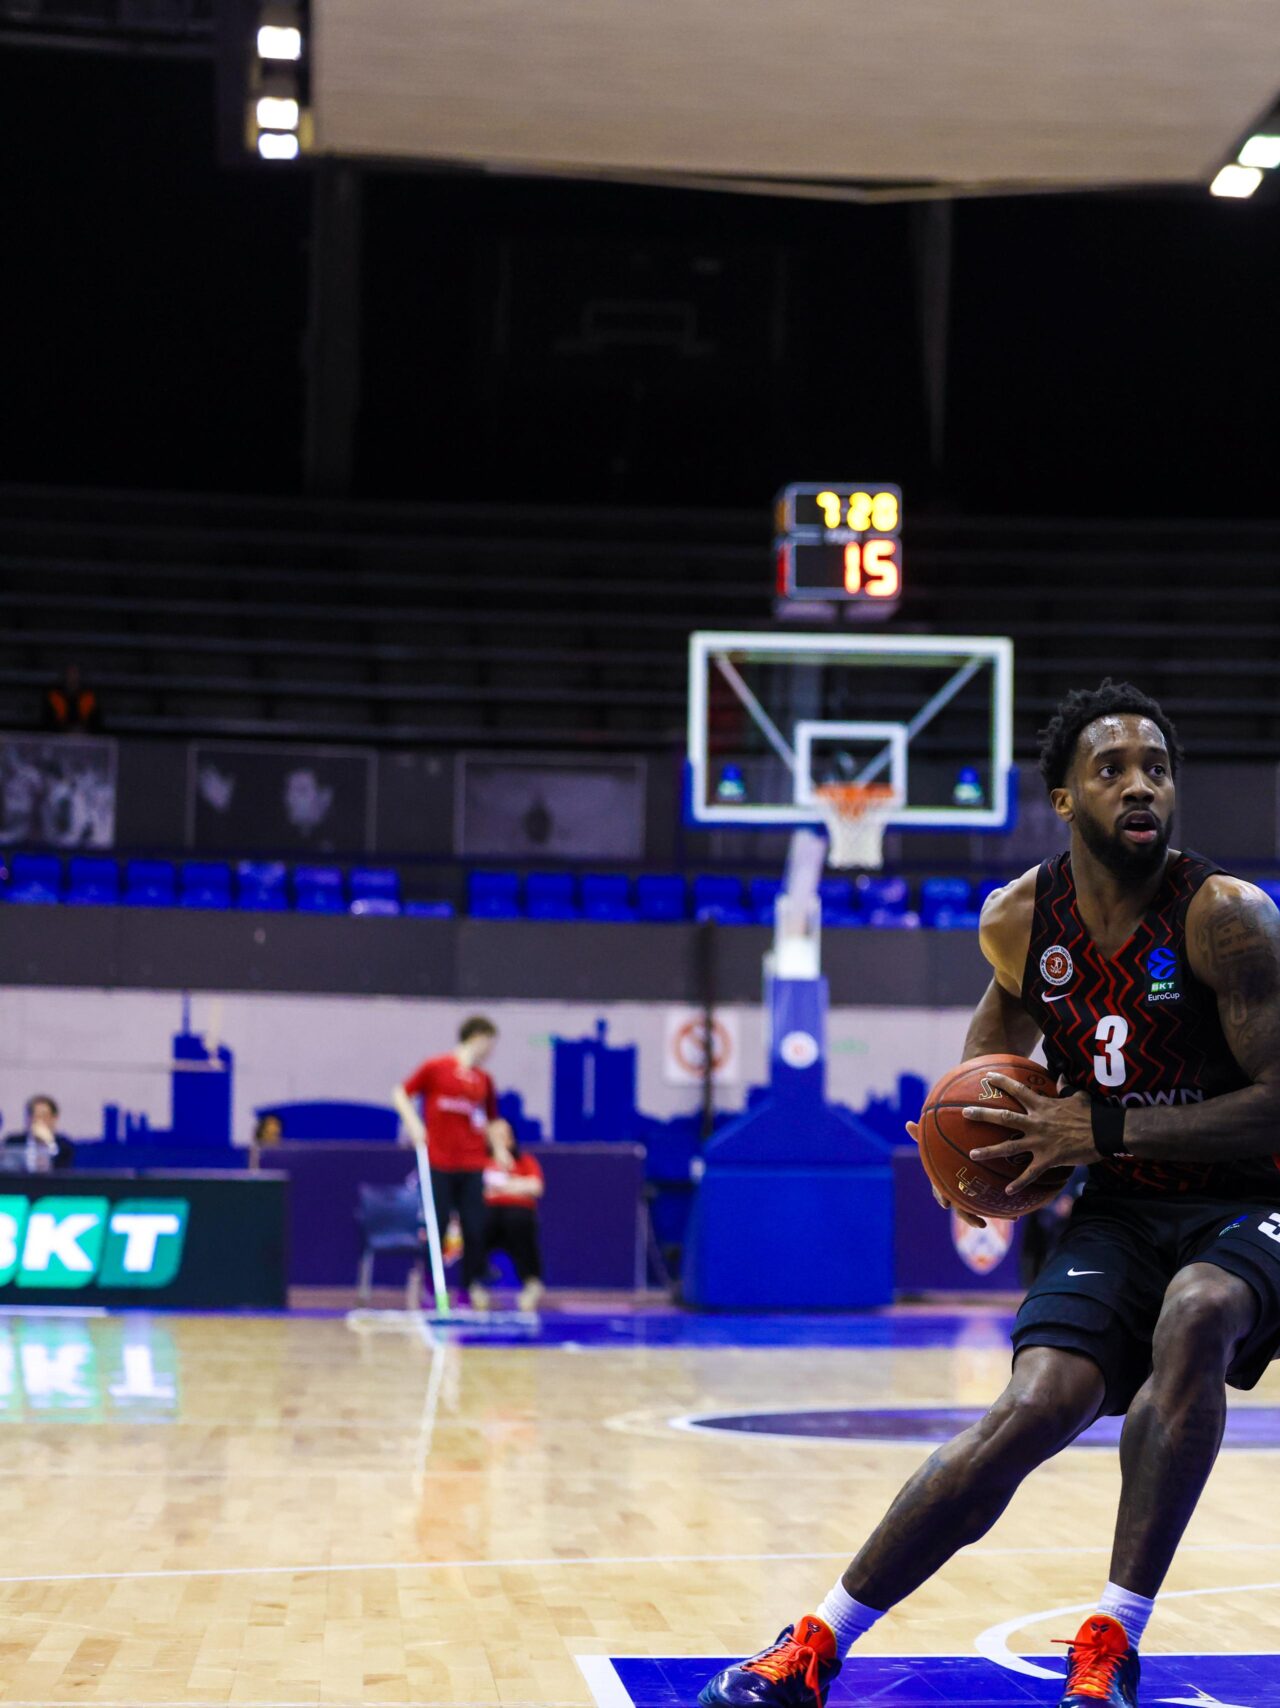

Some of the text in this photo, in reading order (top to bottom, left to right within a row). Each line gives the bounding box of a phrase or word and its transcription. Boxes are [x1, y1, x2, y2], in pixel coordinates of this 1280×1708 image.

[844, 540, 899, 597] 15
[1147, 992, 1181, 1002] EuroCup
[1093, 1015, 1129, 1088] 3
